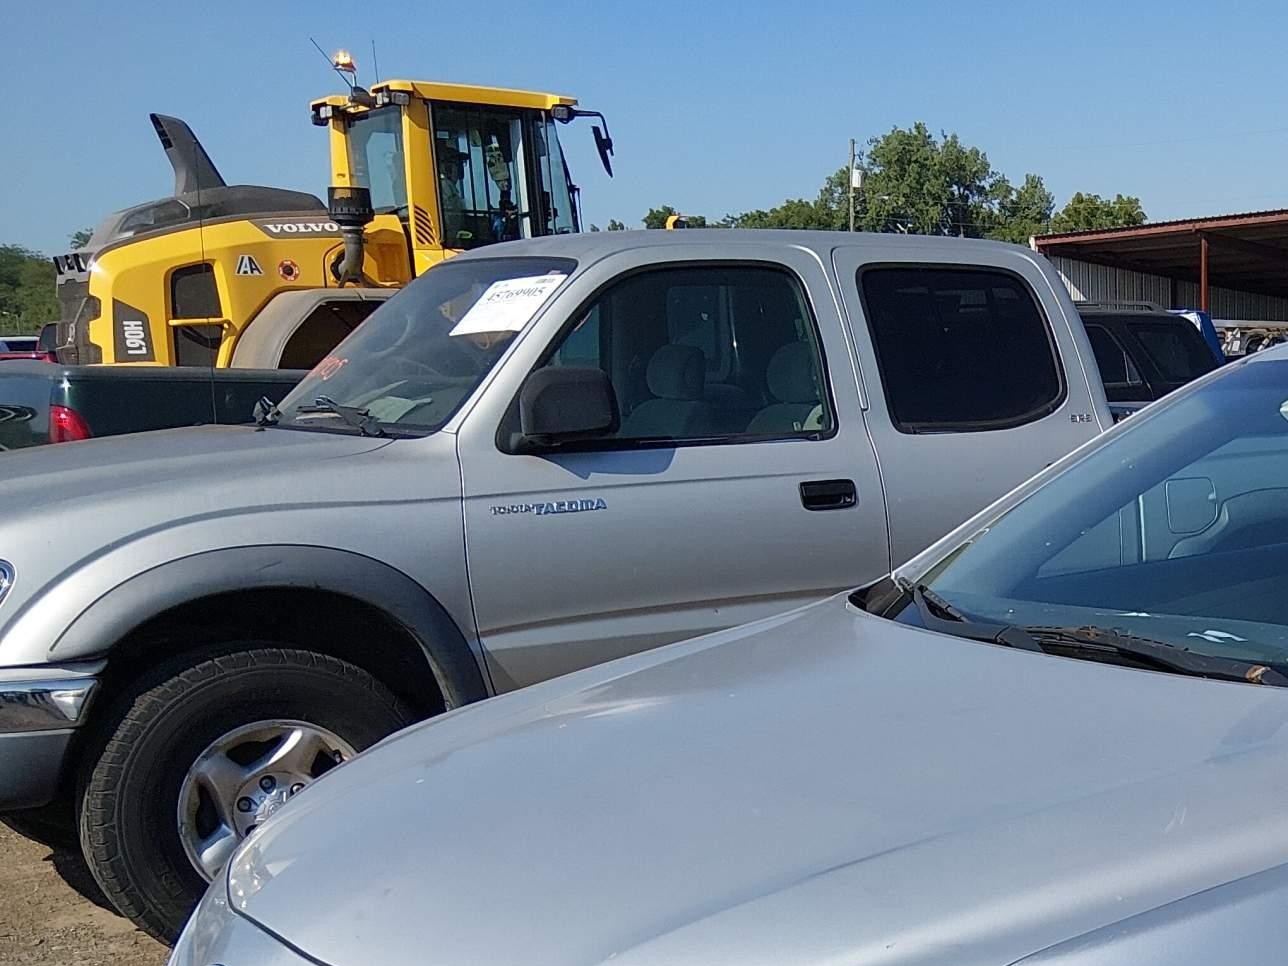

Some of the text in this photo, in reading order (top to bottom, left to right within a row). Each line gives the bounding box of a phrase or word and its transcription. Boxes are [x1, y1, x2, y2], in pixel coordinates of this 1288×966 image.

[264, 222, 339, 233] VOLVO
[122, 320, 148, 355] L90H
[533, 498, 607, 515] TACOMA
